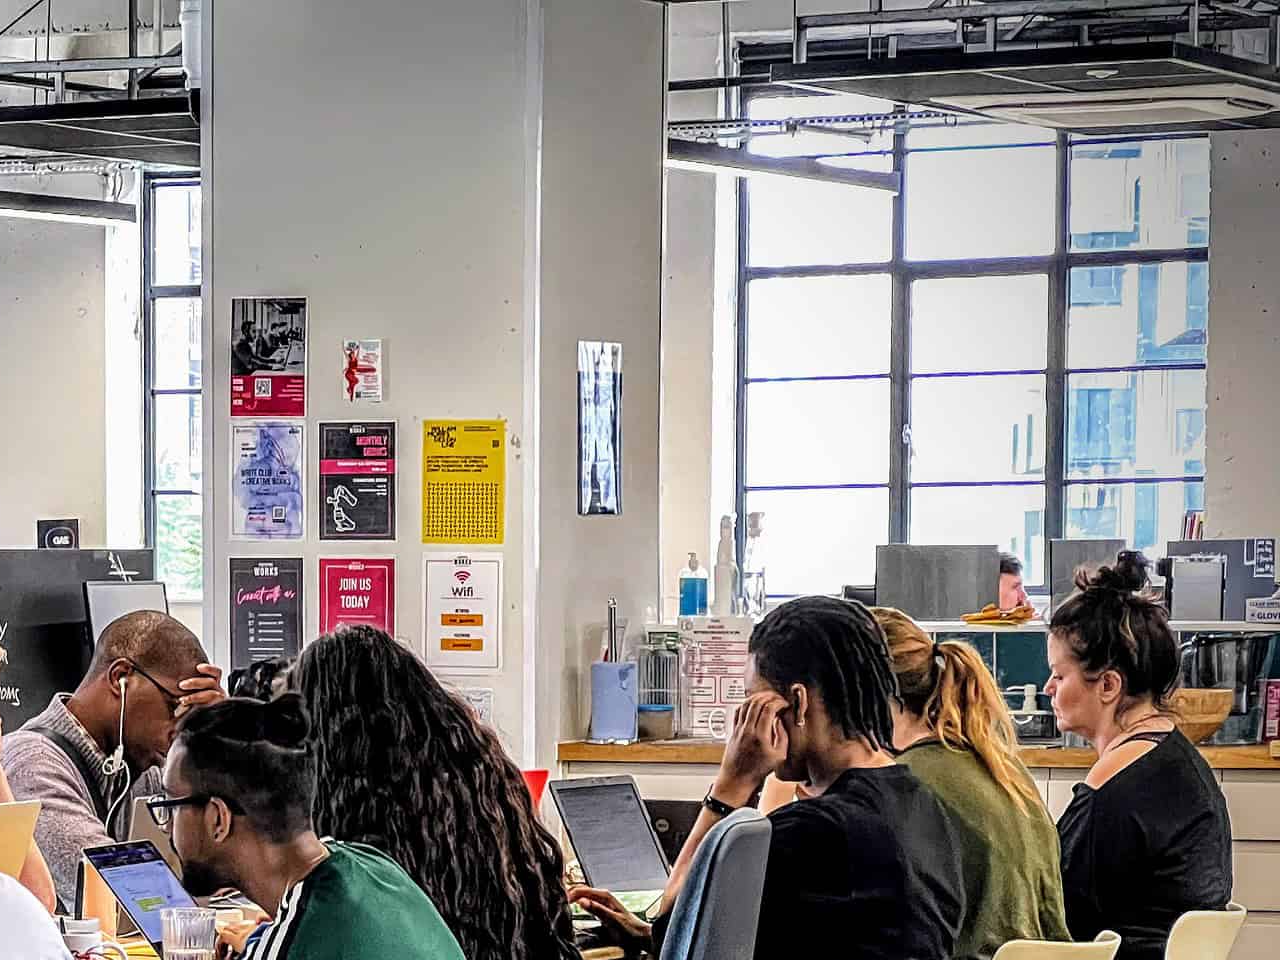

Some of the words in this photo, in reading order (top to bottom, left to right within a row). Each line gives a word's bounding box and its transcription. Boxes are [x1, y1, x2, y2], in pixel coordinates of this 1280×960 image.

[253, 566, 279, 577] WORKS
[338, 577, 357, 591] JOIN
[359, 577, 372, 591] US
[451, 586, 474, 597] Wifi
[339, 595, 370, 609] TODAY
